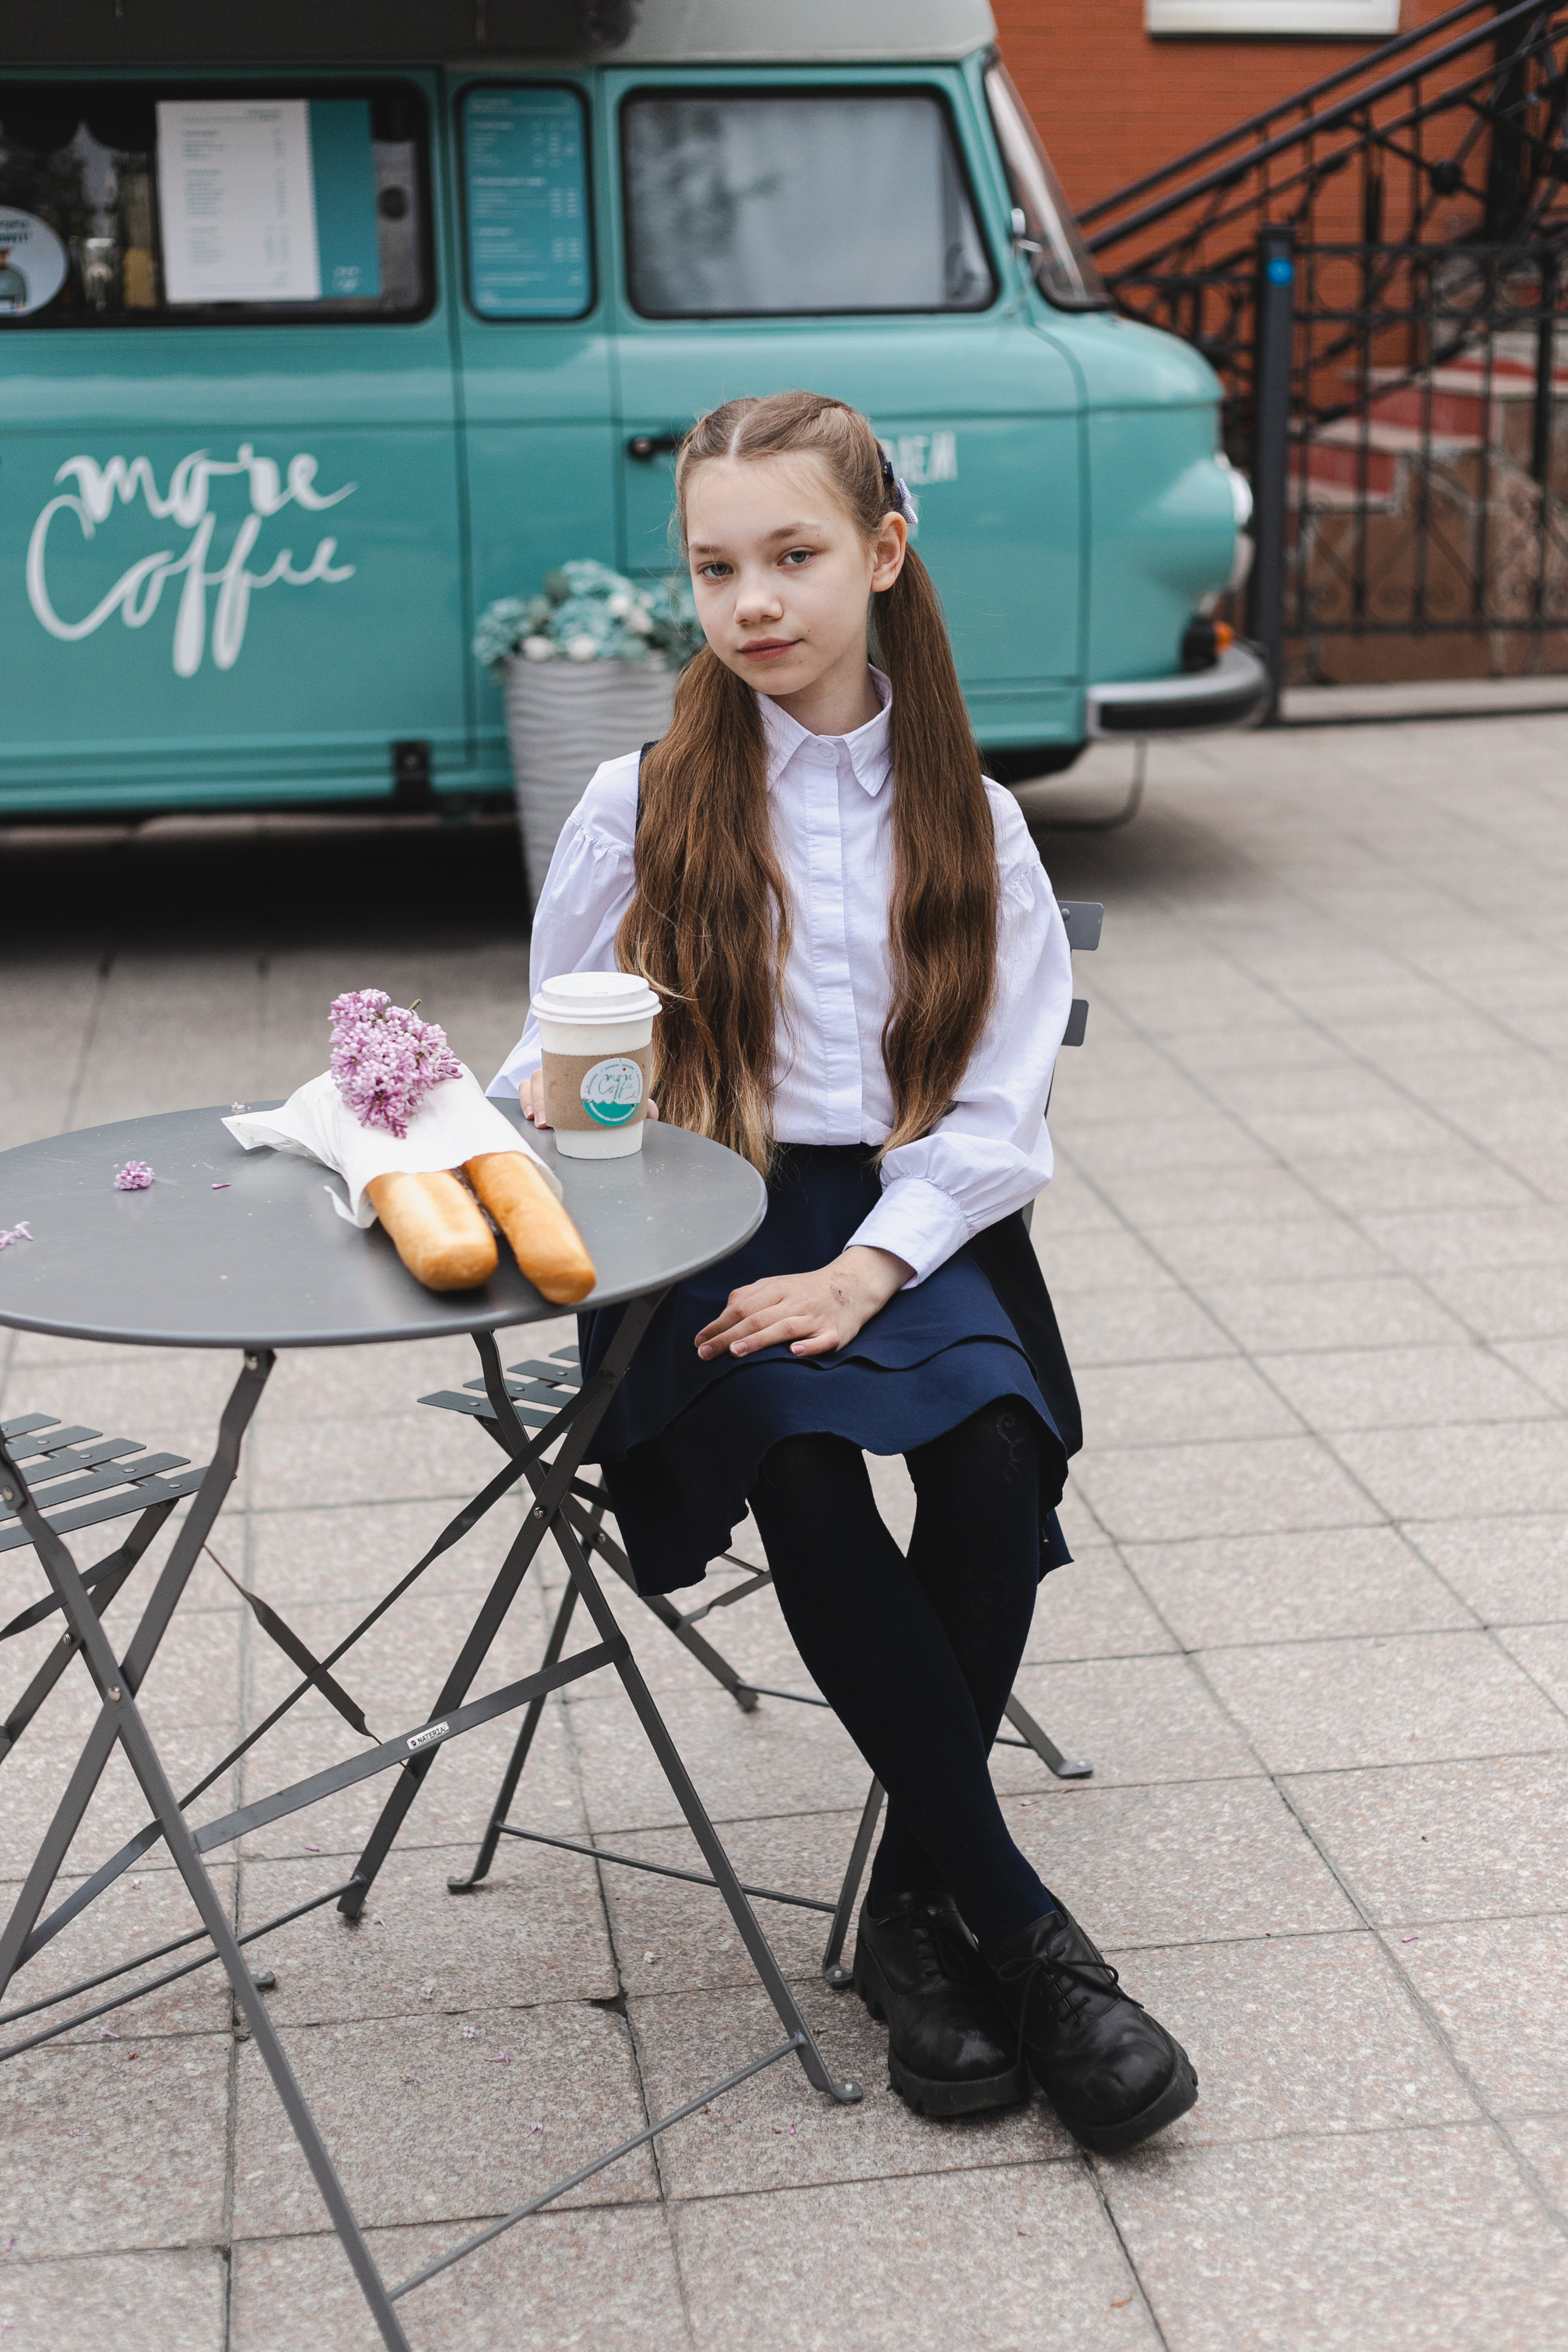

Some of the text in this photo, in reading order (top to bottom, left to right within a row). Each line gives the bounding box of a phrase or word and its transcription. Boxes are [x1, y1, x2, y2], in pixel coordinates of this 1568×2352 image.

[54, 442, 359, 529] more
[26, 494, 356, 677] Coffee
[417, 1725, 450, 1744] NATERIAL
